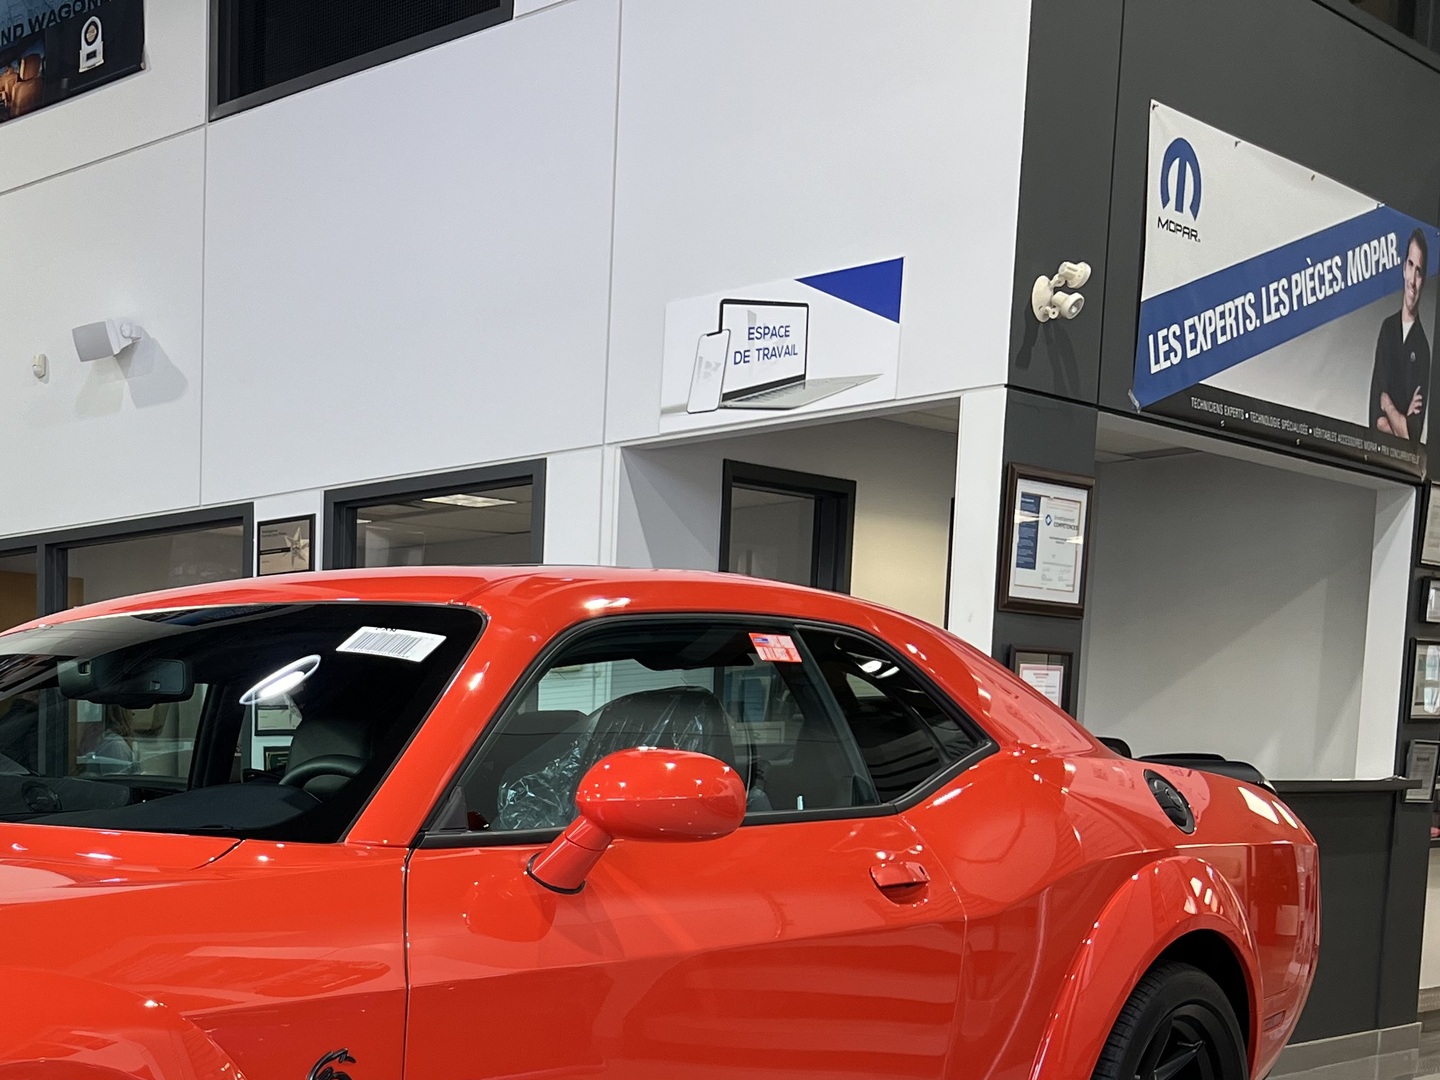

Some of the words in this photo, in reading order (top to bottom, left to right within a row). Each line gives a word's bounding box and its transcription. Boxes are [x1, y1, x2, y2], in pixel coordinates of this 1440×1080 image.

[28, 0, 110, 30] WAGON
[1148, 323, 1182, 375] LES
[1184, 291, 1260, 359] EXPERTS.
[1261, 277, 1289, 325] LES
[1290, 257, 1345, 312] PIÈCES.
[1347, 232, 1401, 287] MOPAR.
[747, 325, 791, 341] ESPACE
[733, 349, 751, 366] DE
[755, 344, 798, 361] TRAVAIL
[1190, 396, 1224, 416] TECHNICIENS
[1224, 404, 1245, 420] EXPERTS
